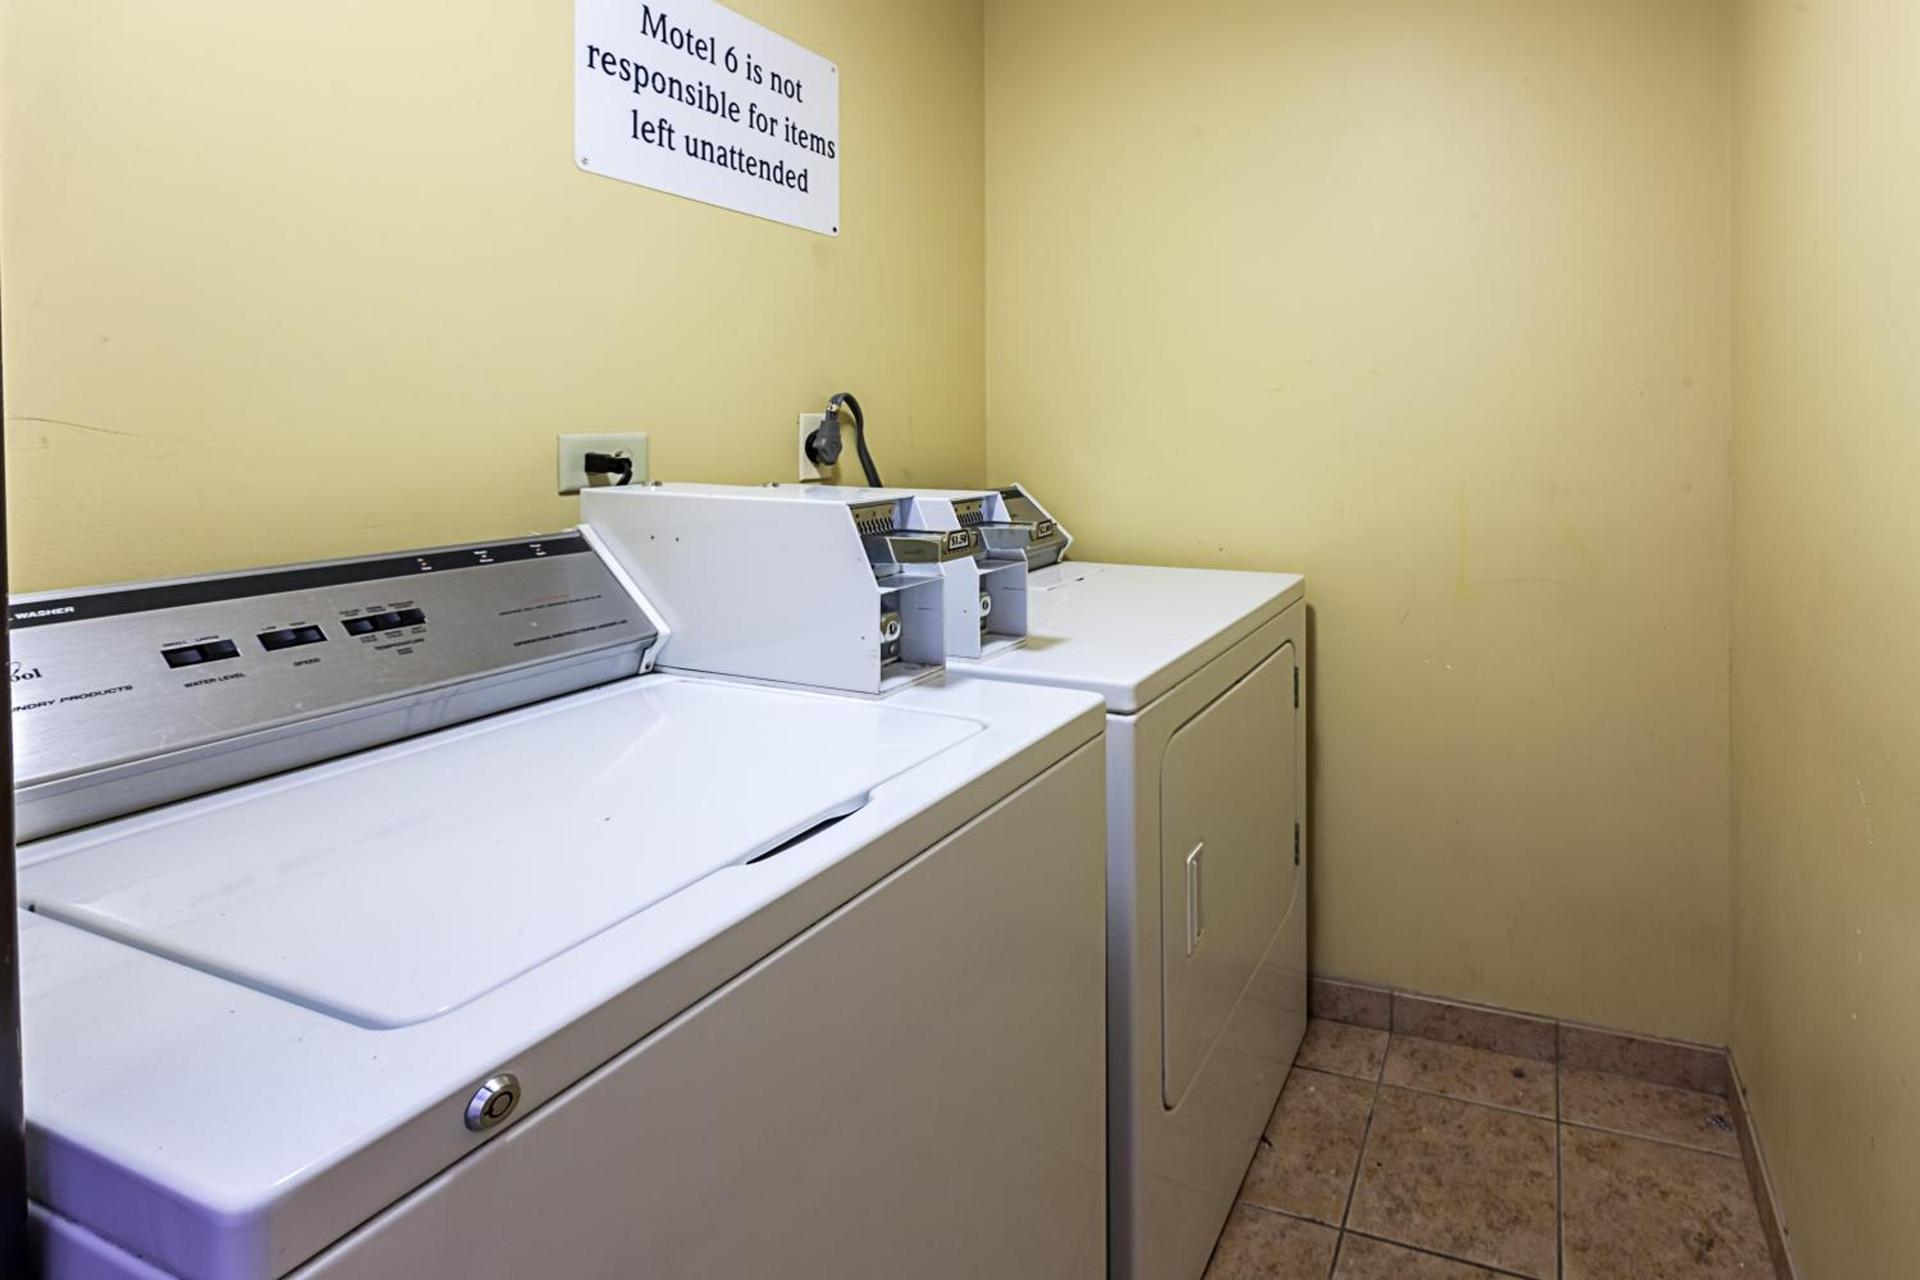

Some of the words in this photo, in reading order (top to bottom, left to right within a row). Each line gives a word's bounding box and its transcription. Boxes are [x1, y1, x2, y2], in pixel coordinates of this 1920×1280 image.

[640, 4, 716, 66] Motel
[724, 46, 738, 73] 6
[746, 54, 763, 85] is
[770, 71, 803, 103] not
[587, 44, 740, 123] responsible
[748, 103, 778, 137] for
[784, 117, 836, 160] items
[631, 109, 676, 151] left
[685, 134, 809, 194] unattended
[14, 606, 75, 619] WASHER
[60, 684, 133, 703] PRODUCTS
[184, 678, 217, 689] WATER
[219, 672, 247, 682] LEVEL
